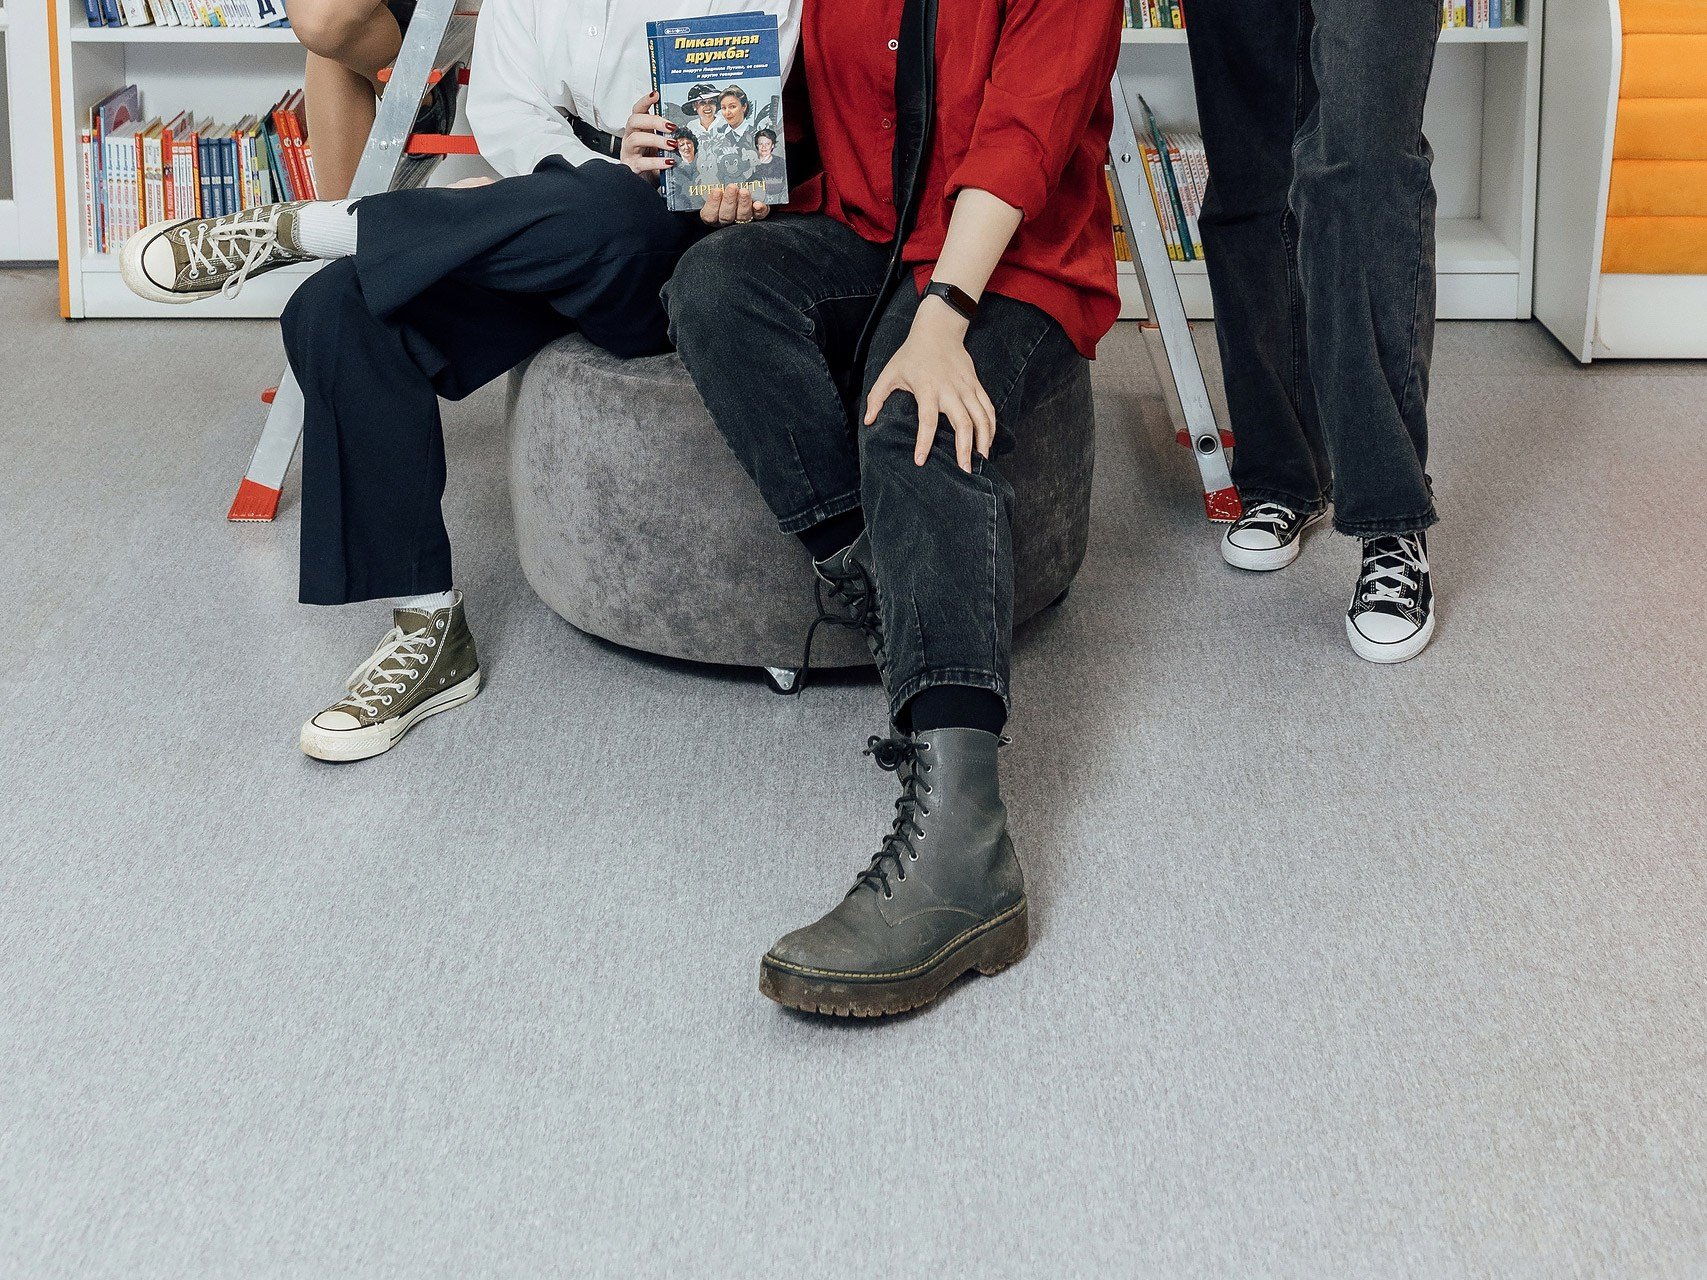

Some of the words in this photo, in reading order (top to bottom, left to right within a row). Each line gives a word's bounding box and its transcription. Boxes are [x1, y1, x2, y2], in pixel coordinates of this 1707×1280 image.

[674, 34, 760, 50] Пикантная
[648, 39, 657, 75] дружба
[684, 46, 750, 64] дружба:
[736, 180, 766, 193] ИТЧ
